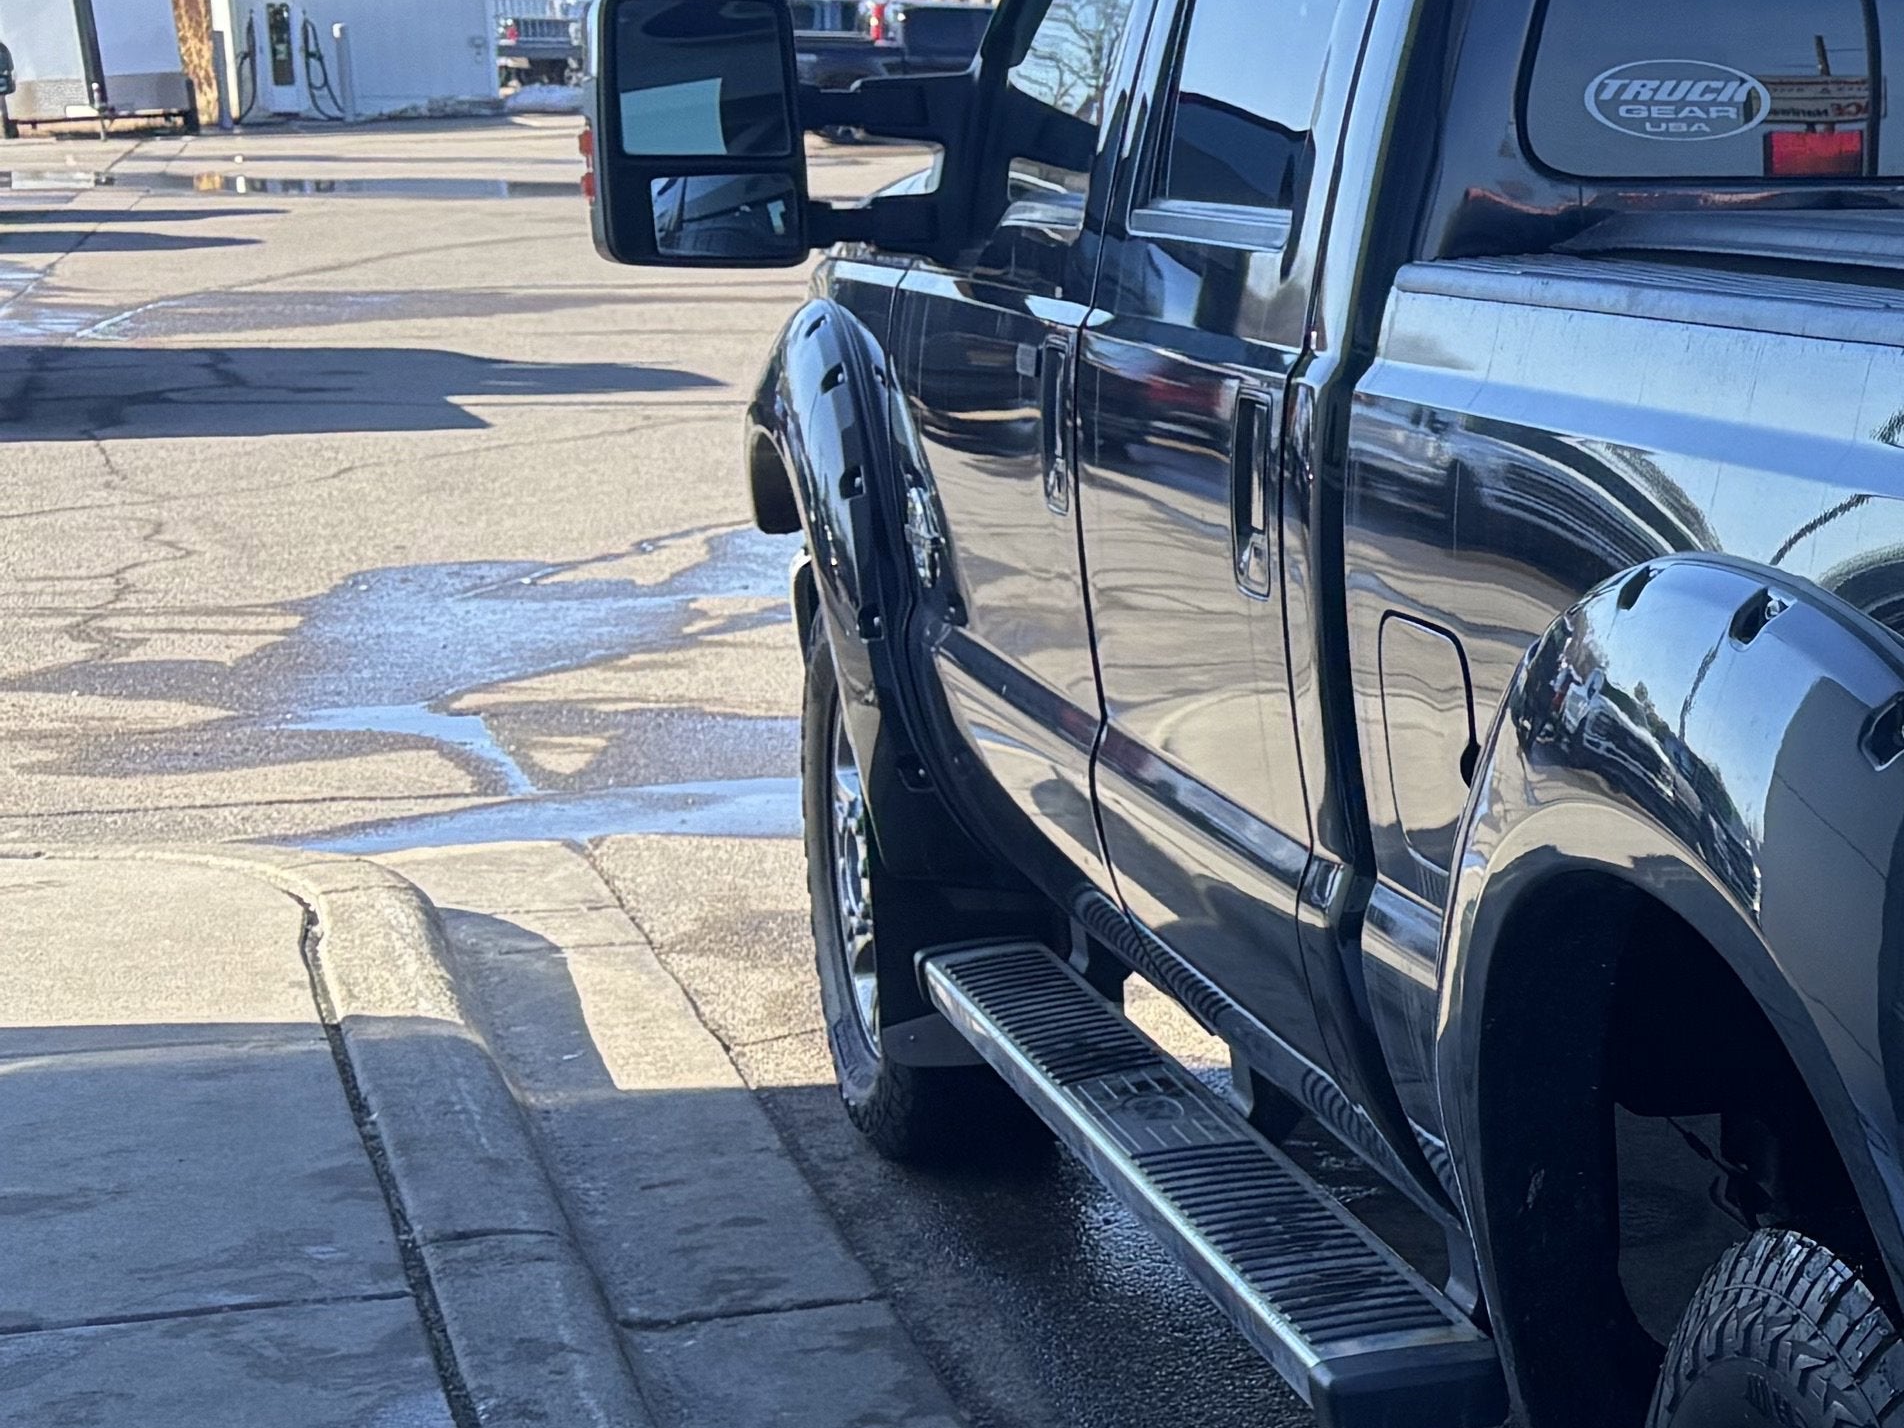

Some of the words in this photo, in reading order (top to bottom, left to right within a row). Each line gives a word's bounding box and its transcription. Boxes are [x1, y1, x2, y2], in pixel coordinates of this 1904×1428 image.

[1600, 79, 1754, 102] TRUCK
[1618, 105, 1737, 119] GEAR
[1645, 122, 1711, 133] USA
